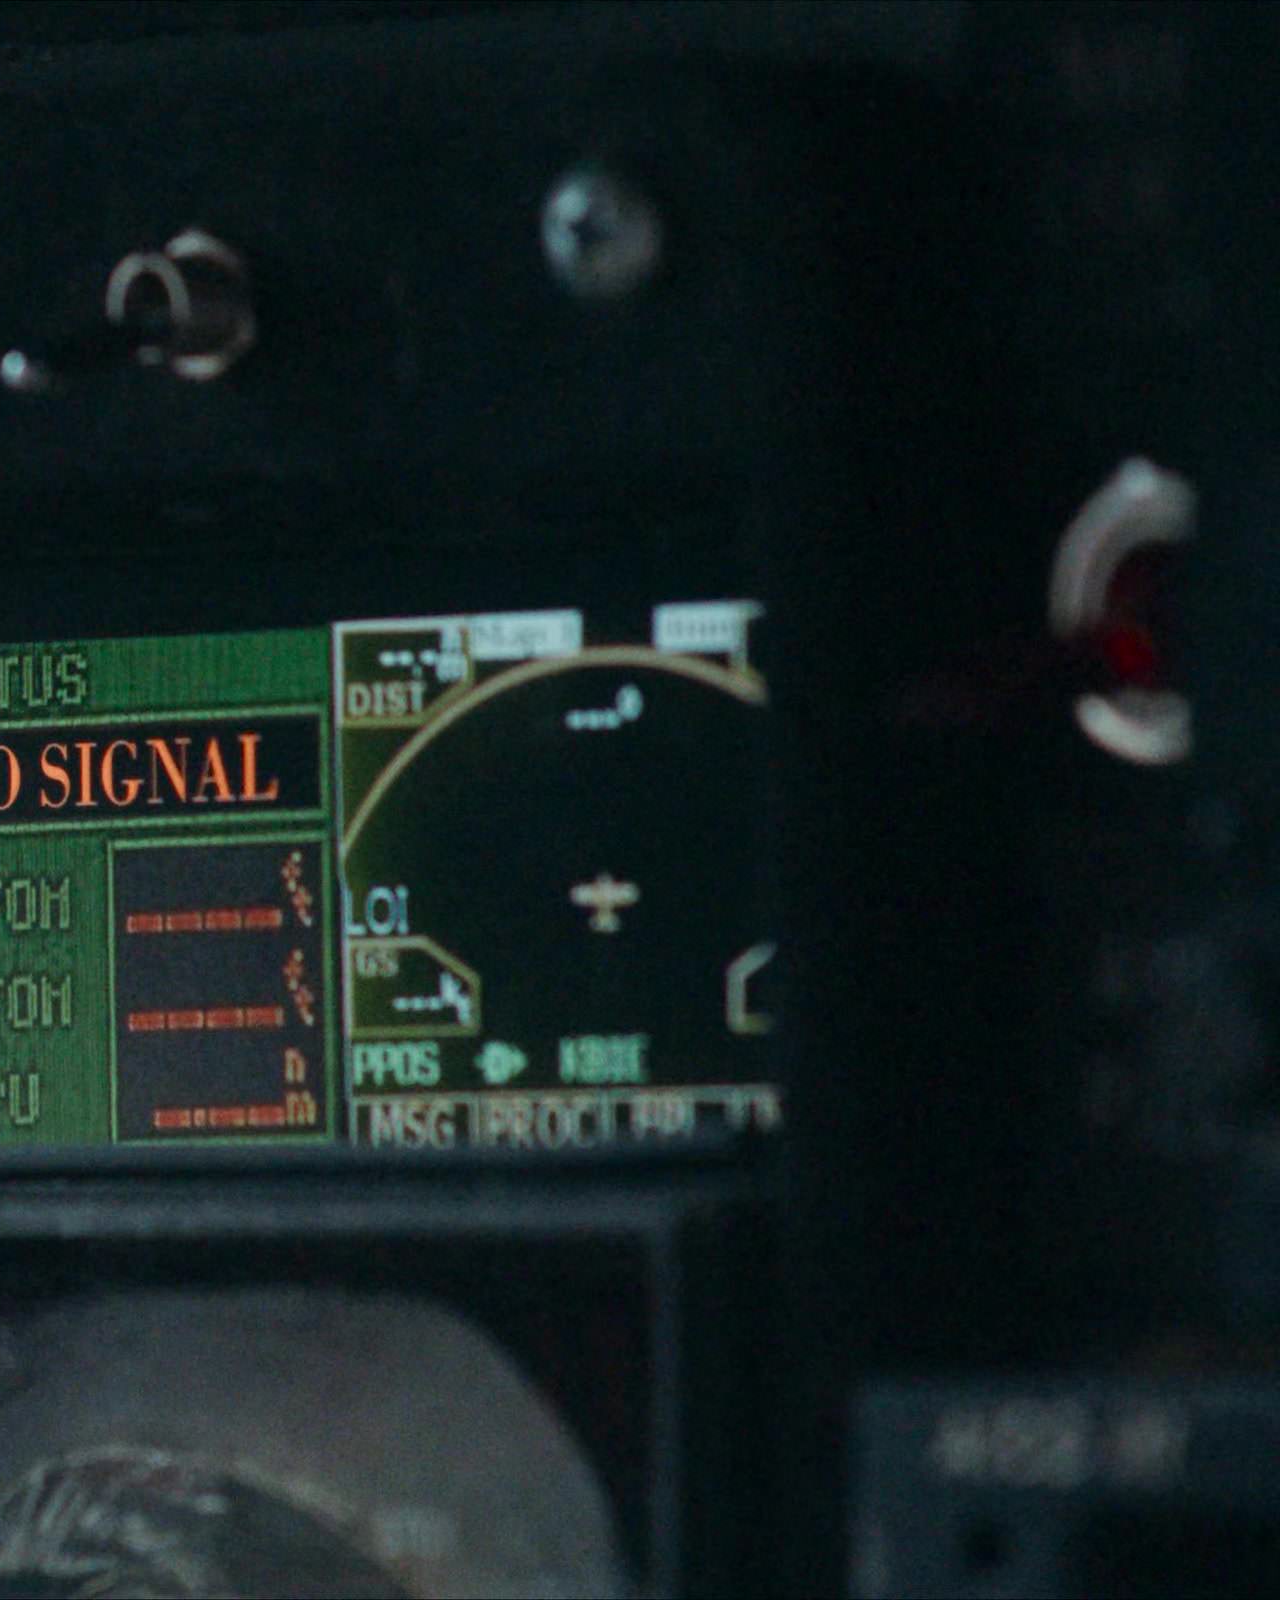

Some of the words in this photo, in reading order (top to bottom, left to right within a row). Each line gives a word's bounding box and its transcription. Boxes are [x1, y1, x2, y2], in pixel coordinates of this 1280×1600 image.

[347, 681, 424, 718] DIST
[39, 732, 280, 810] SIGNAL
[350, 1039, 441, 1087] PPOS
